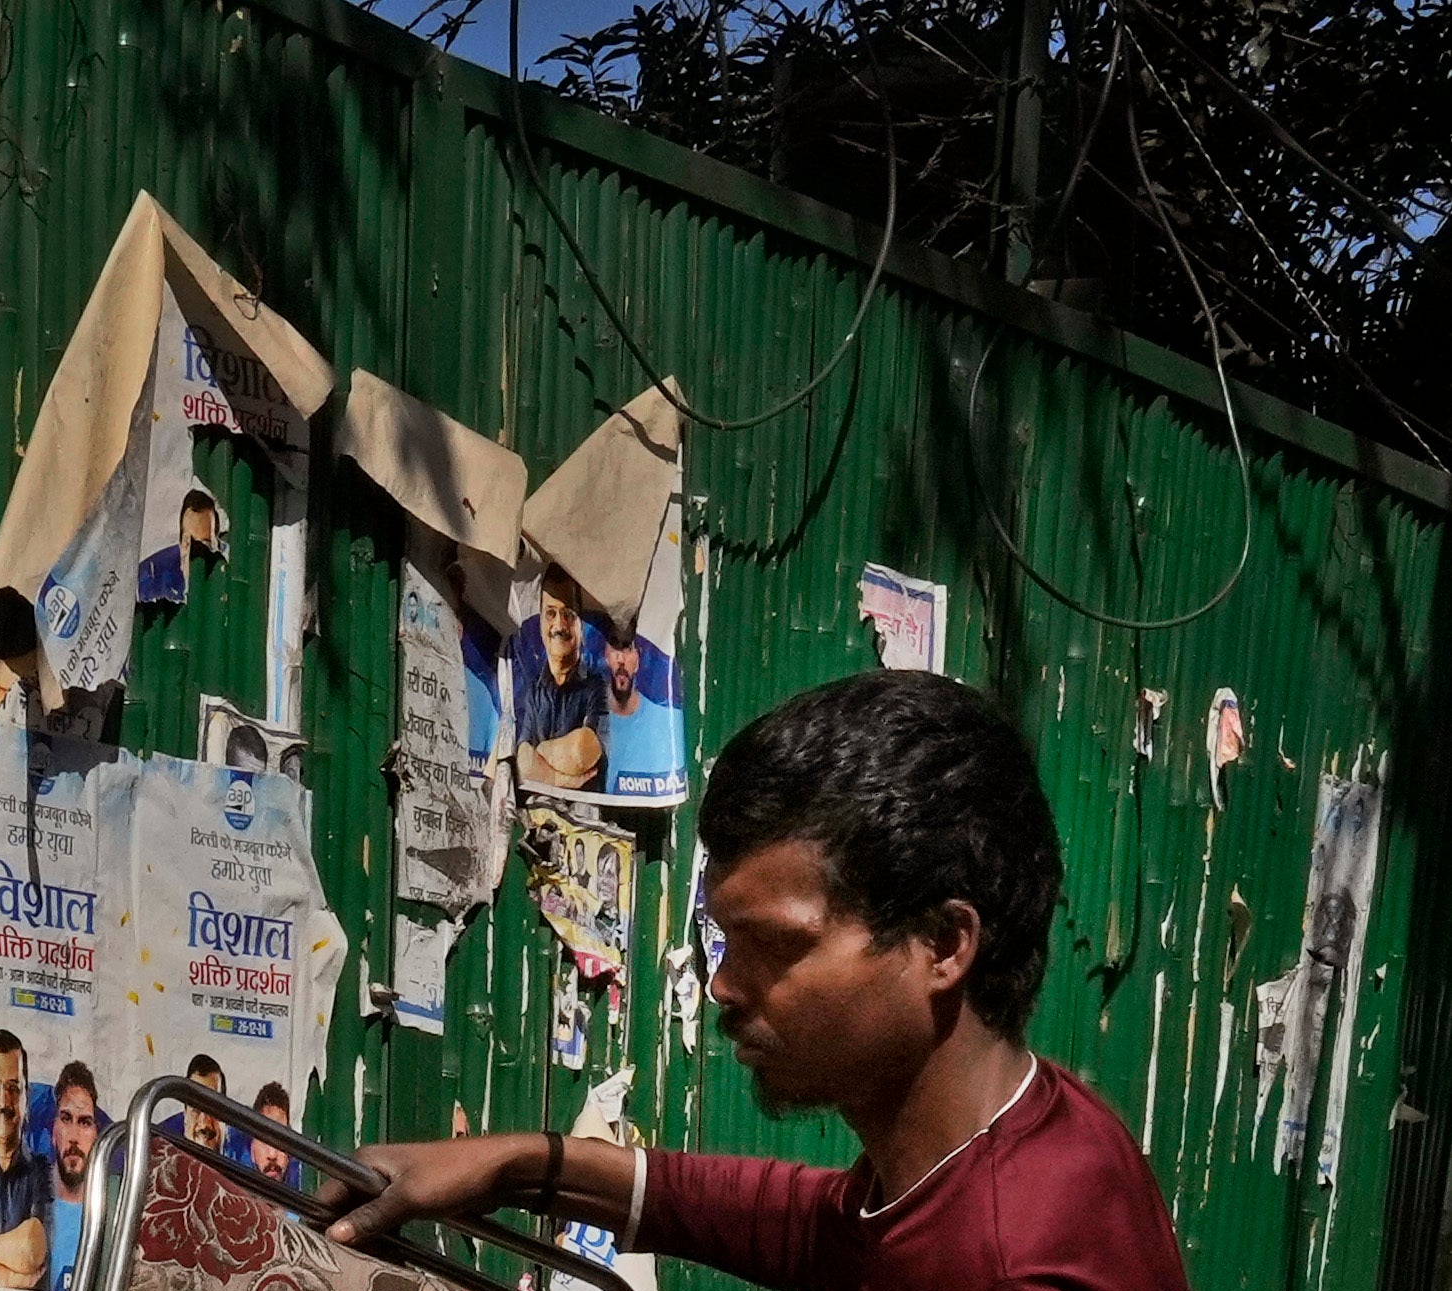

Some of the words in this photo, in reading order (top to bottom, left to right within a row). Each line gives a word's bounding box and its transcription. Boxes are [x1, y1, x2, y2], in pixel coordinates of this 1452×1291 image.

[618, 776, 652, 792] ROHIT
[228, 788, 252, 817] aap
[46, 831, 75, 861] युवा
[191, 827, 218, 849] दिल्ली
[219, 833, 232, 852] को
[211, 855, 246, 881] हमारे
[247, 864, 273, 893] युवा
[187, 890, 293, 960] विशाल
[35, 936, 95, 972] प्रदर्शन
[189, 954, 232, 988] शक्ति
[235, 963, 292, 997] प्रदर्शन
